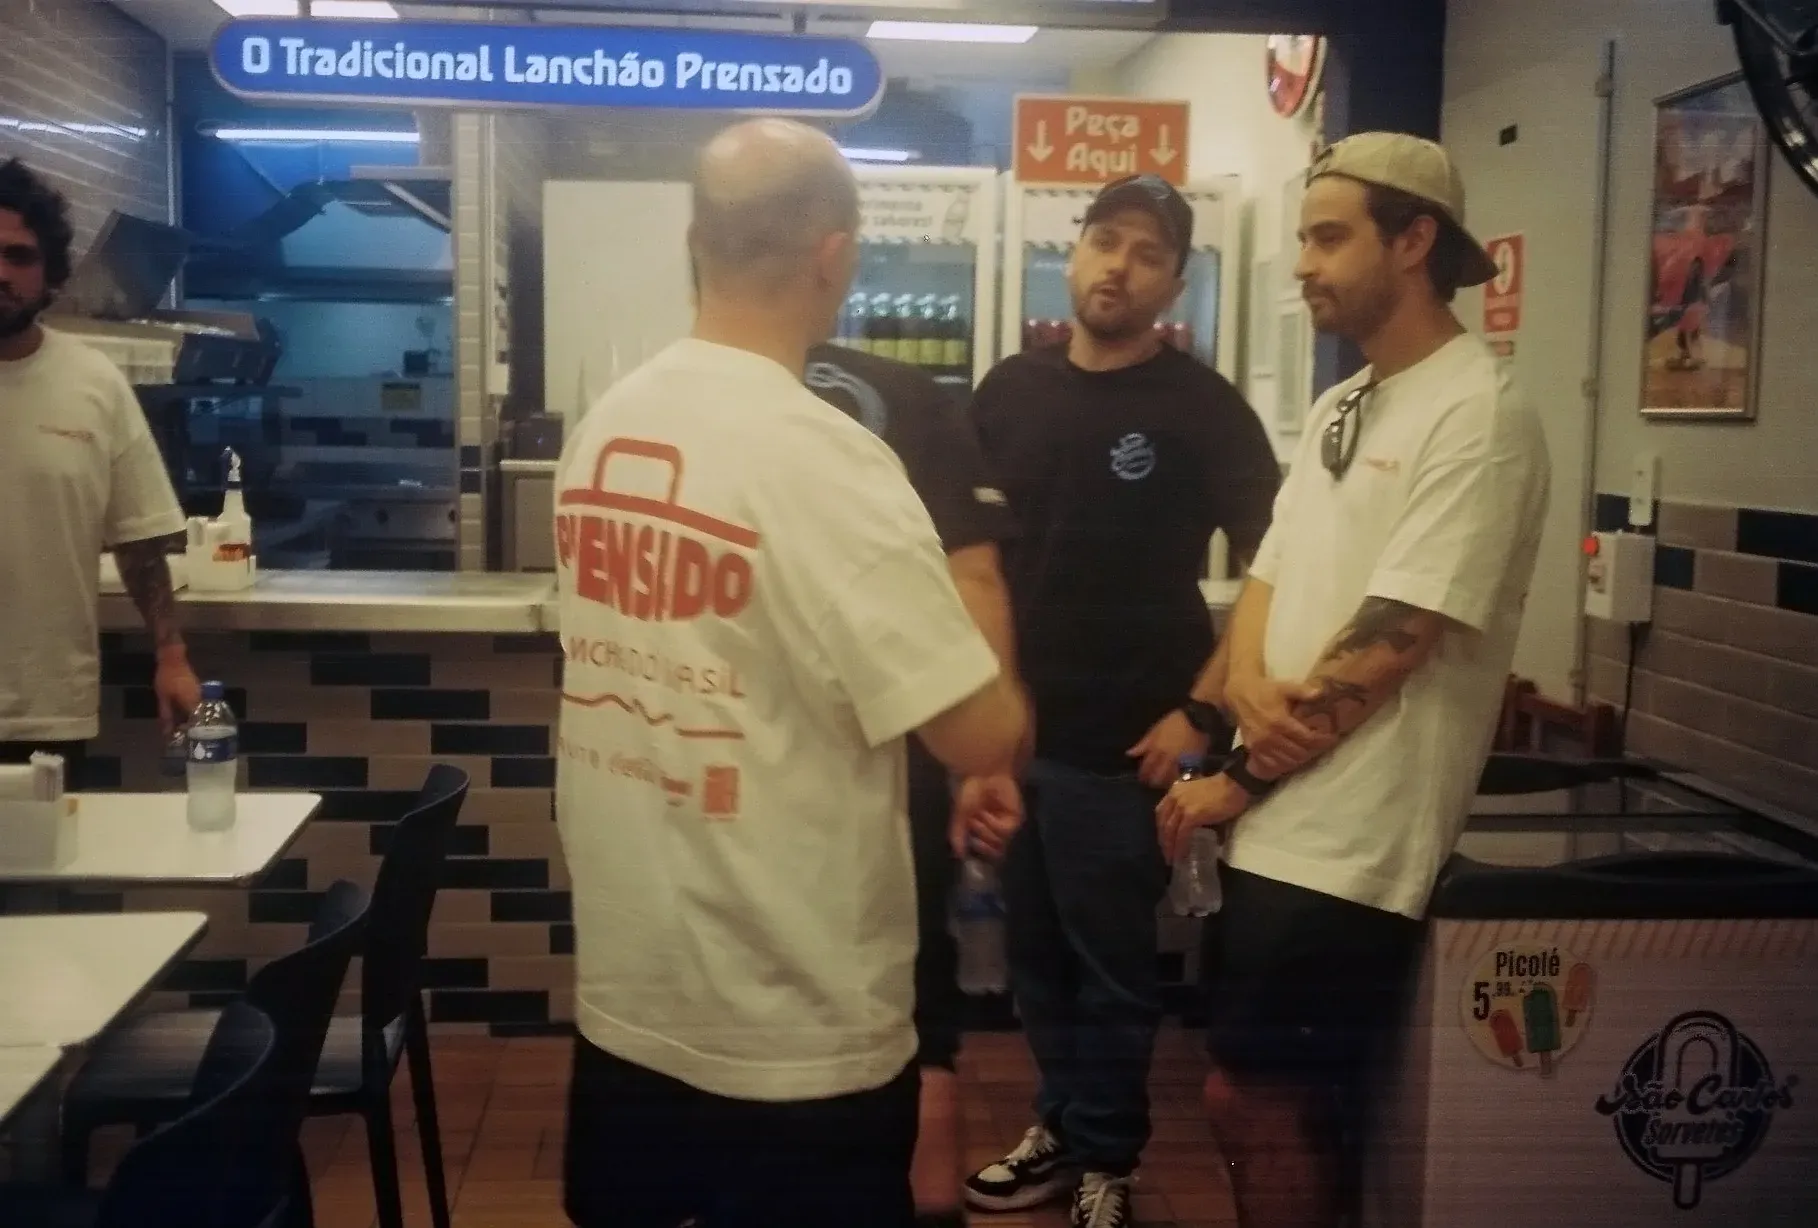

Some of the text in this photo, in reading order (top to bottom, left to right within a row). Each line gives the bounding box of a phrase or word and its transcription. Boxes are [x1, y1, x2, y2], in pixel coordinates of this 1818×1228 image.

[241, 37, 853, 96] O Tradicional Lanchão Prensado
[1065, 106, 1140, 144] Peça
[1066, 142, 1136, 174] Aqui
[1495, 947, 1560, 977] Picolé
